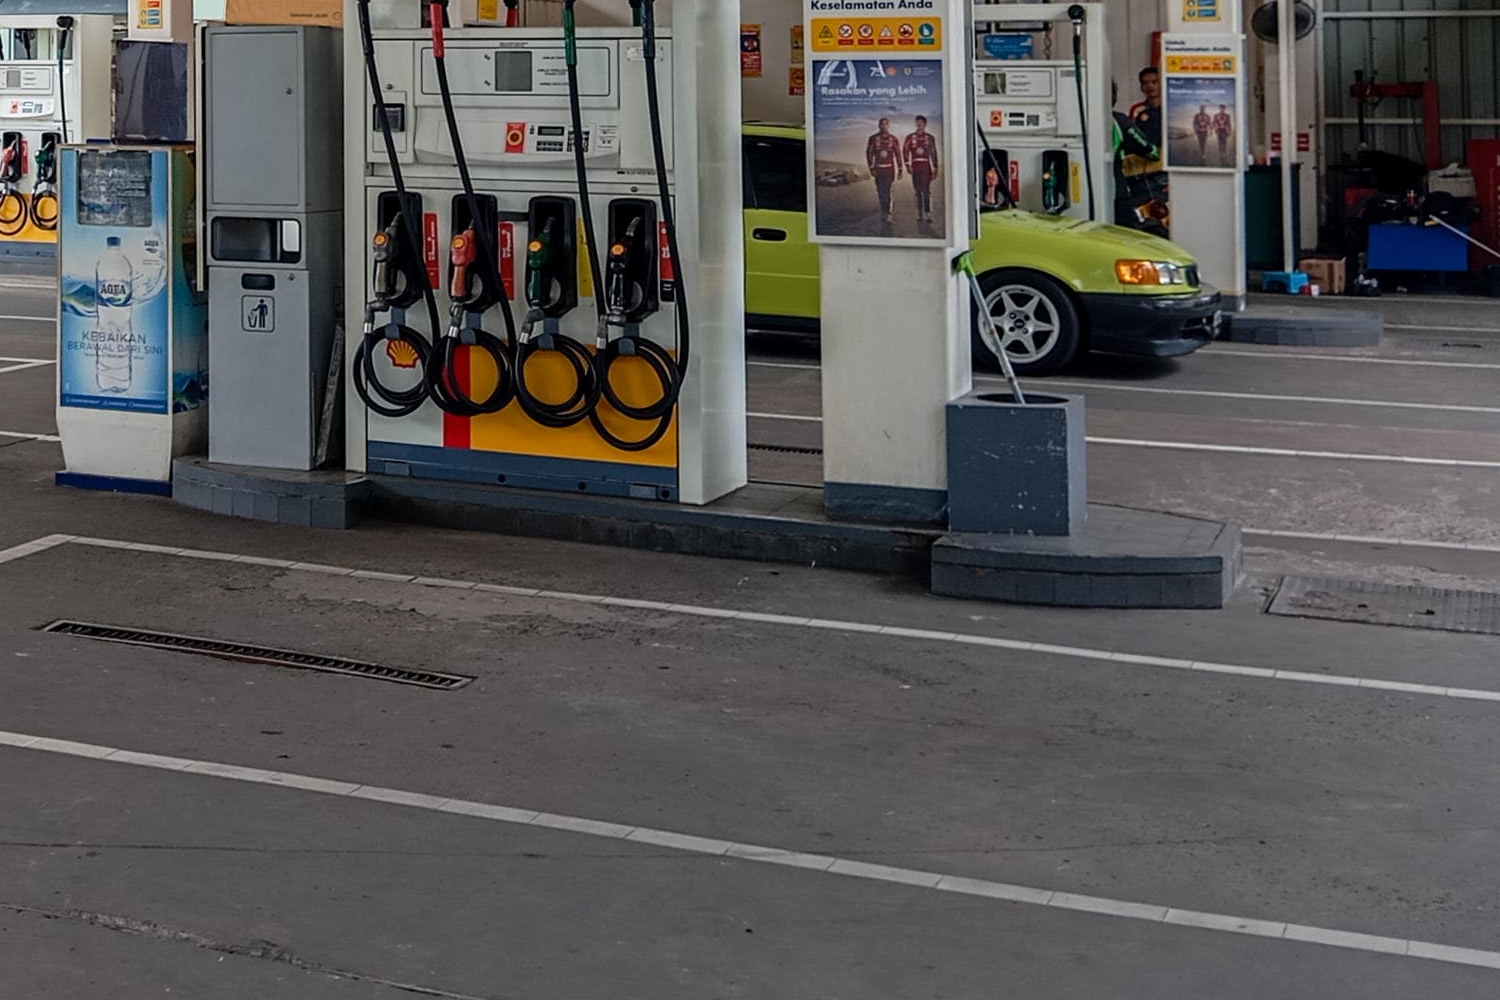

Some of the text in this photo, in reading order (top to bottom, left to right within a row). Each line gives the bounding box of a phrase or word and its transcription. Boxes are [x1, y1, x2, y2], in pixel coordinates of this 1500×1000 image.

[811, 0, 895, 11] Keselamatan
[821, 84, 927, 97] Rasakan yang Lebih
[100, 283, 126, 296] AQUA
[82, 330, 147, 345] KEBAIKAN
[67, 341, 115, 352] BERAWAL
